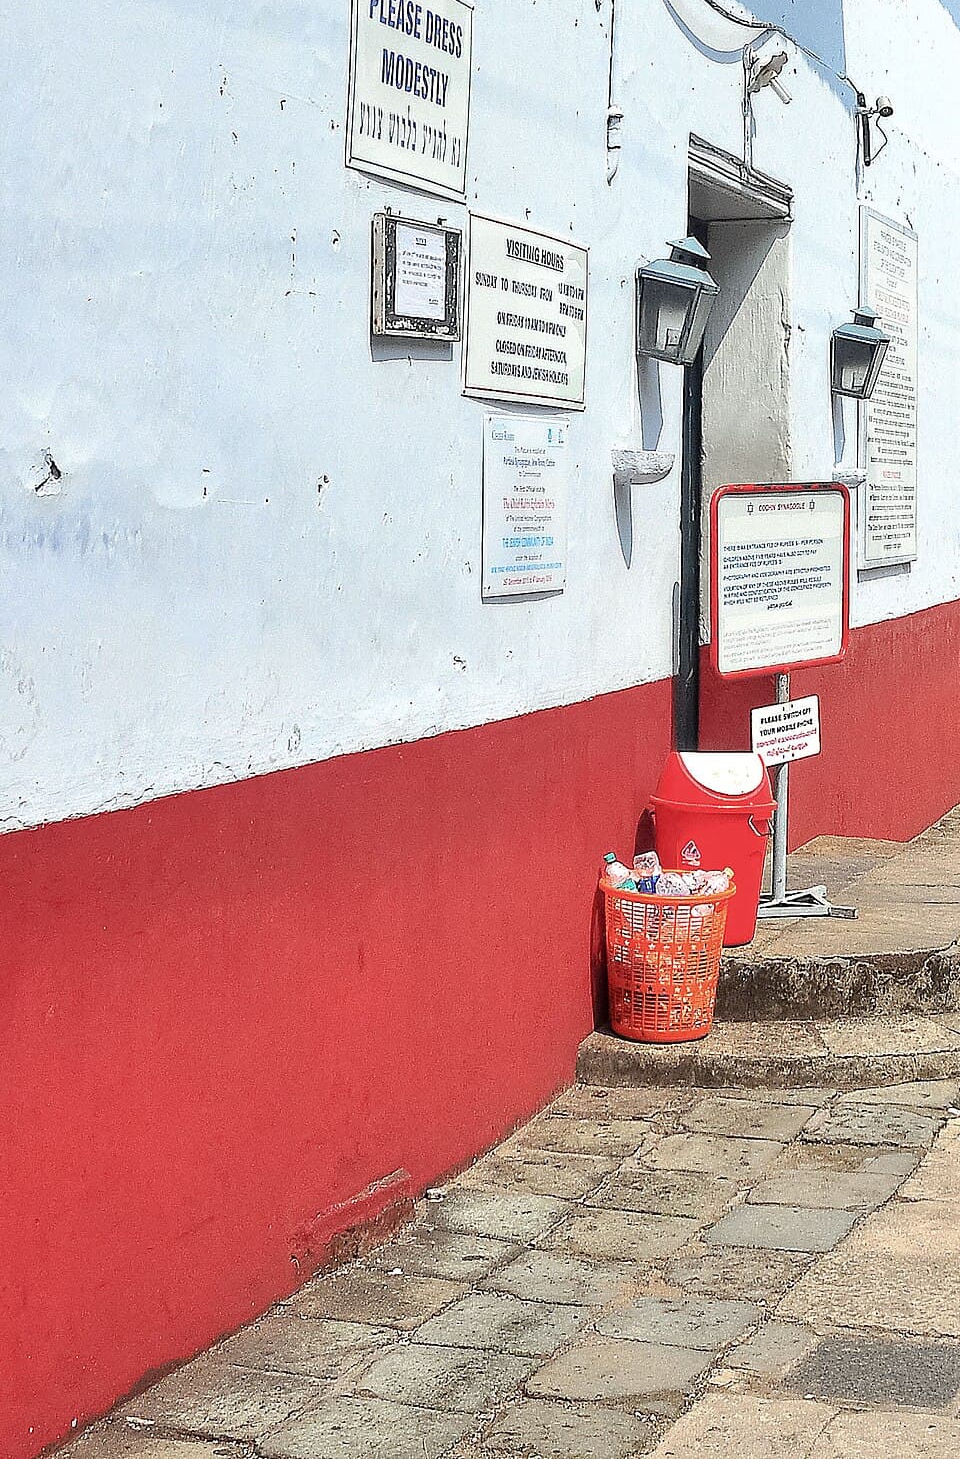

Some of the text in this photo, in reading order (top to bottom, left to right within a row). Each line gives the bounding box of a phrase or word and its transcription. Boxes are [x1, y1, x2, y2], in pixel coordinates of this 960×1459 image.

[425, 9, 463, 59] DRESS
[381, 48, 449, 108] MODESTLY
[506, 238, 564, 270] VISITING HOURS
[475, 271, 498, 289] SUNDAY
[500, 277, 509, 292] TO
[496, 339, 516, 355] CLOSED
[760, 714, 782, 725] PLEASE
[760, 727, 776, 737] YOUR
[777, 722, 796, 733] MOBILE
